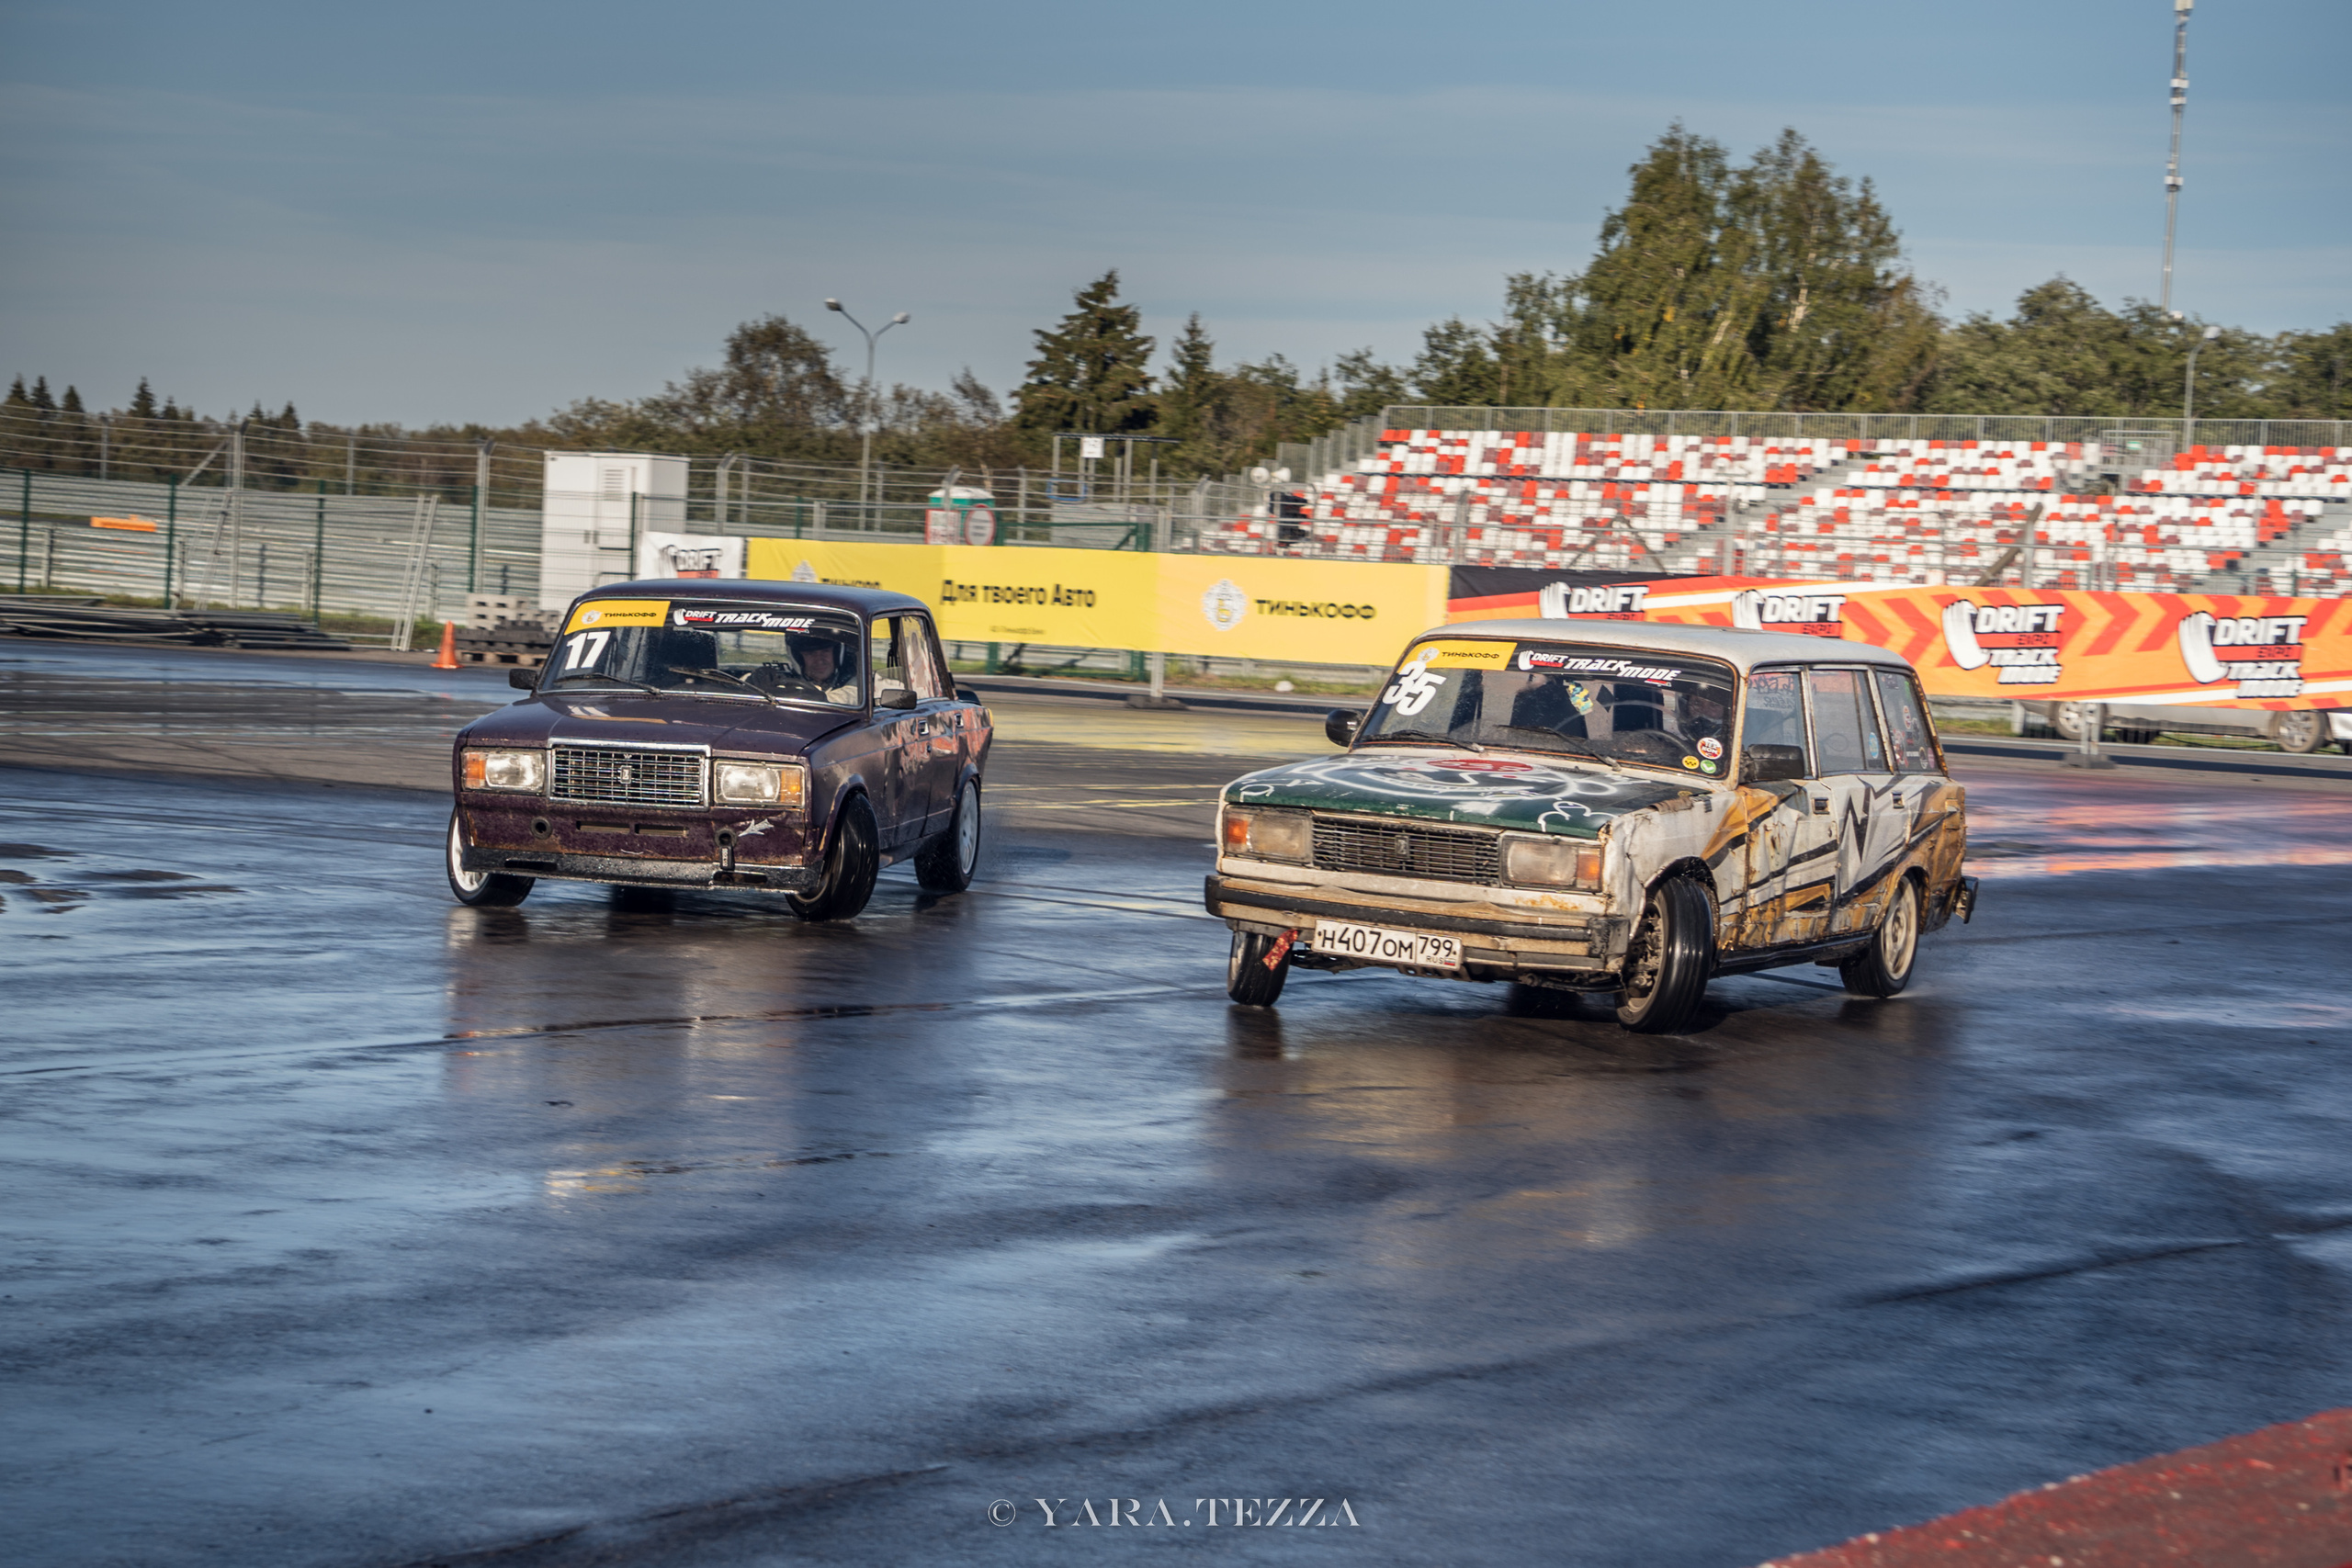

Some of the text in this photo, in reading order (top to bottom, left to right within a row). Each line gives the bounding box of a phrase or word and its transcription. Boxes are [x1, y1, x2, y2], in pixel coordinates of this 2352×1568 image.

[940, 580, 1097, 608] Для твоего Авто
[1568, 586, 1649, 613] DRIFT
[684, 610, 718, 619] DRIFT
[1254, 599, 1376, 620] ТИНЬКОФФ
[1761, 596, 1847, 623] DRIFT
[1974, 605, 2065, 633] DRIFT
[2212, 616, 2308, 645] DRIFT
[564, 631, 612, 671] 17
[1532, 652, 1568, 663] DRIFT
[1382, 660, 1447, 716] 35
[1419, 936, 1454, 957] 799
[1426, 955, 1444, 964] RUS
